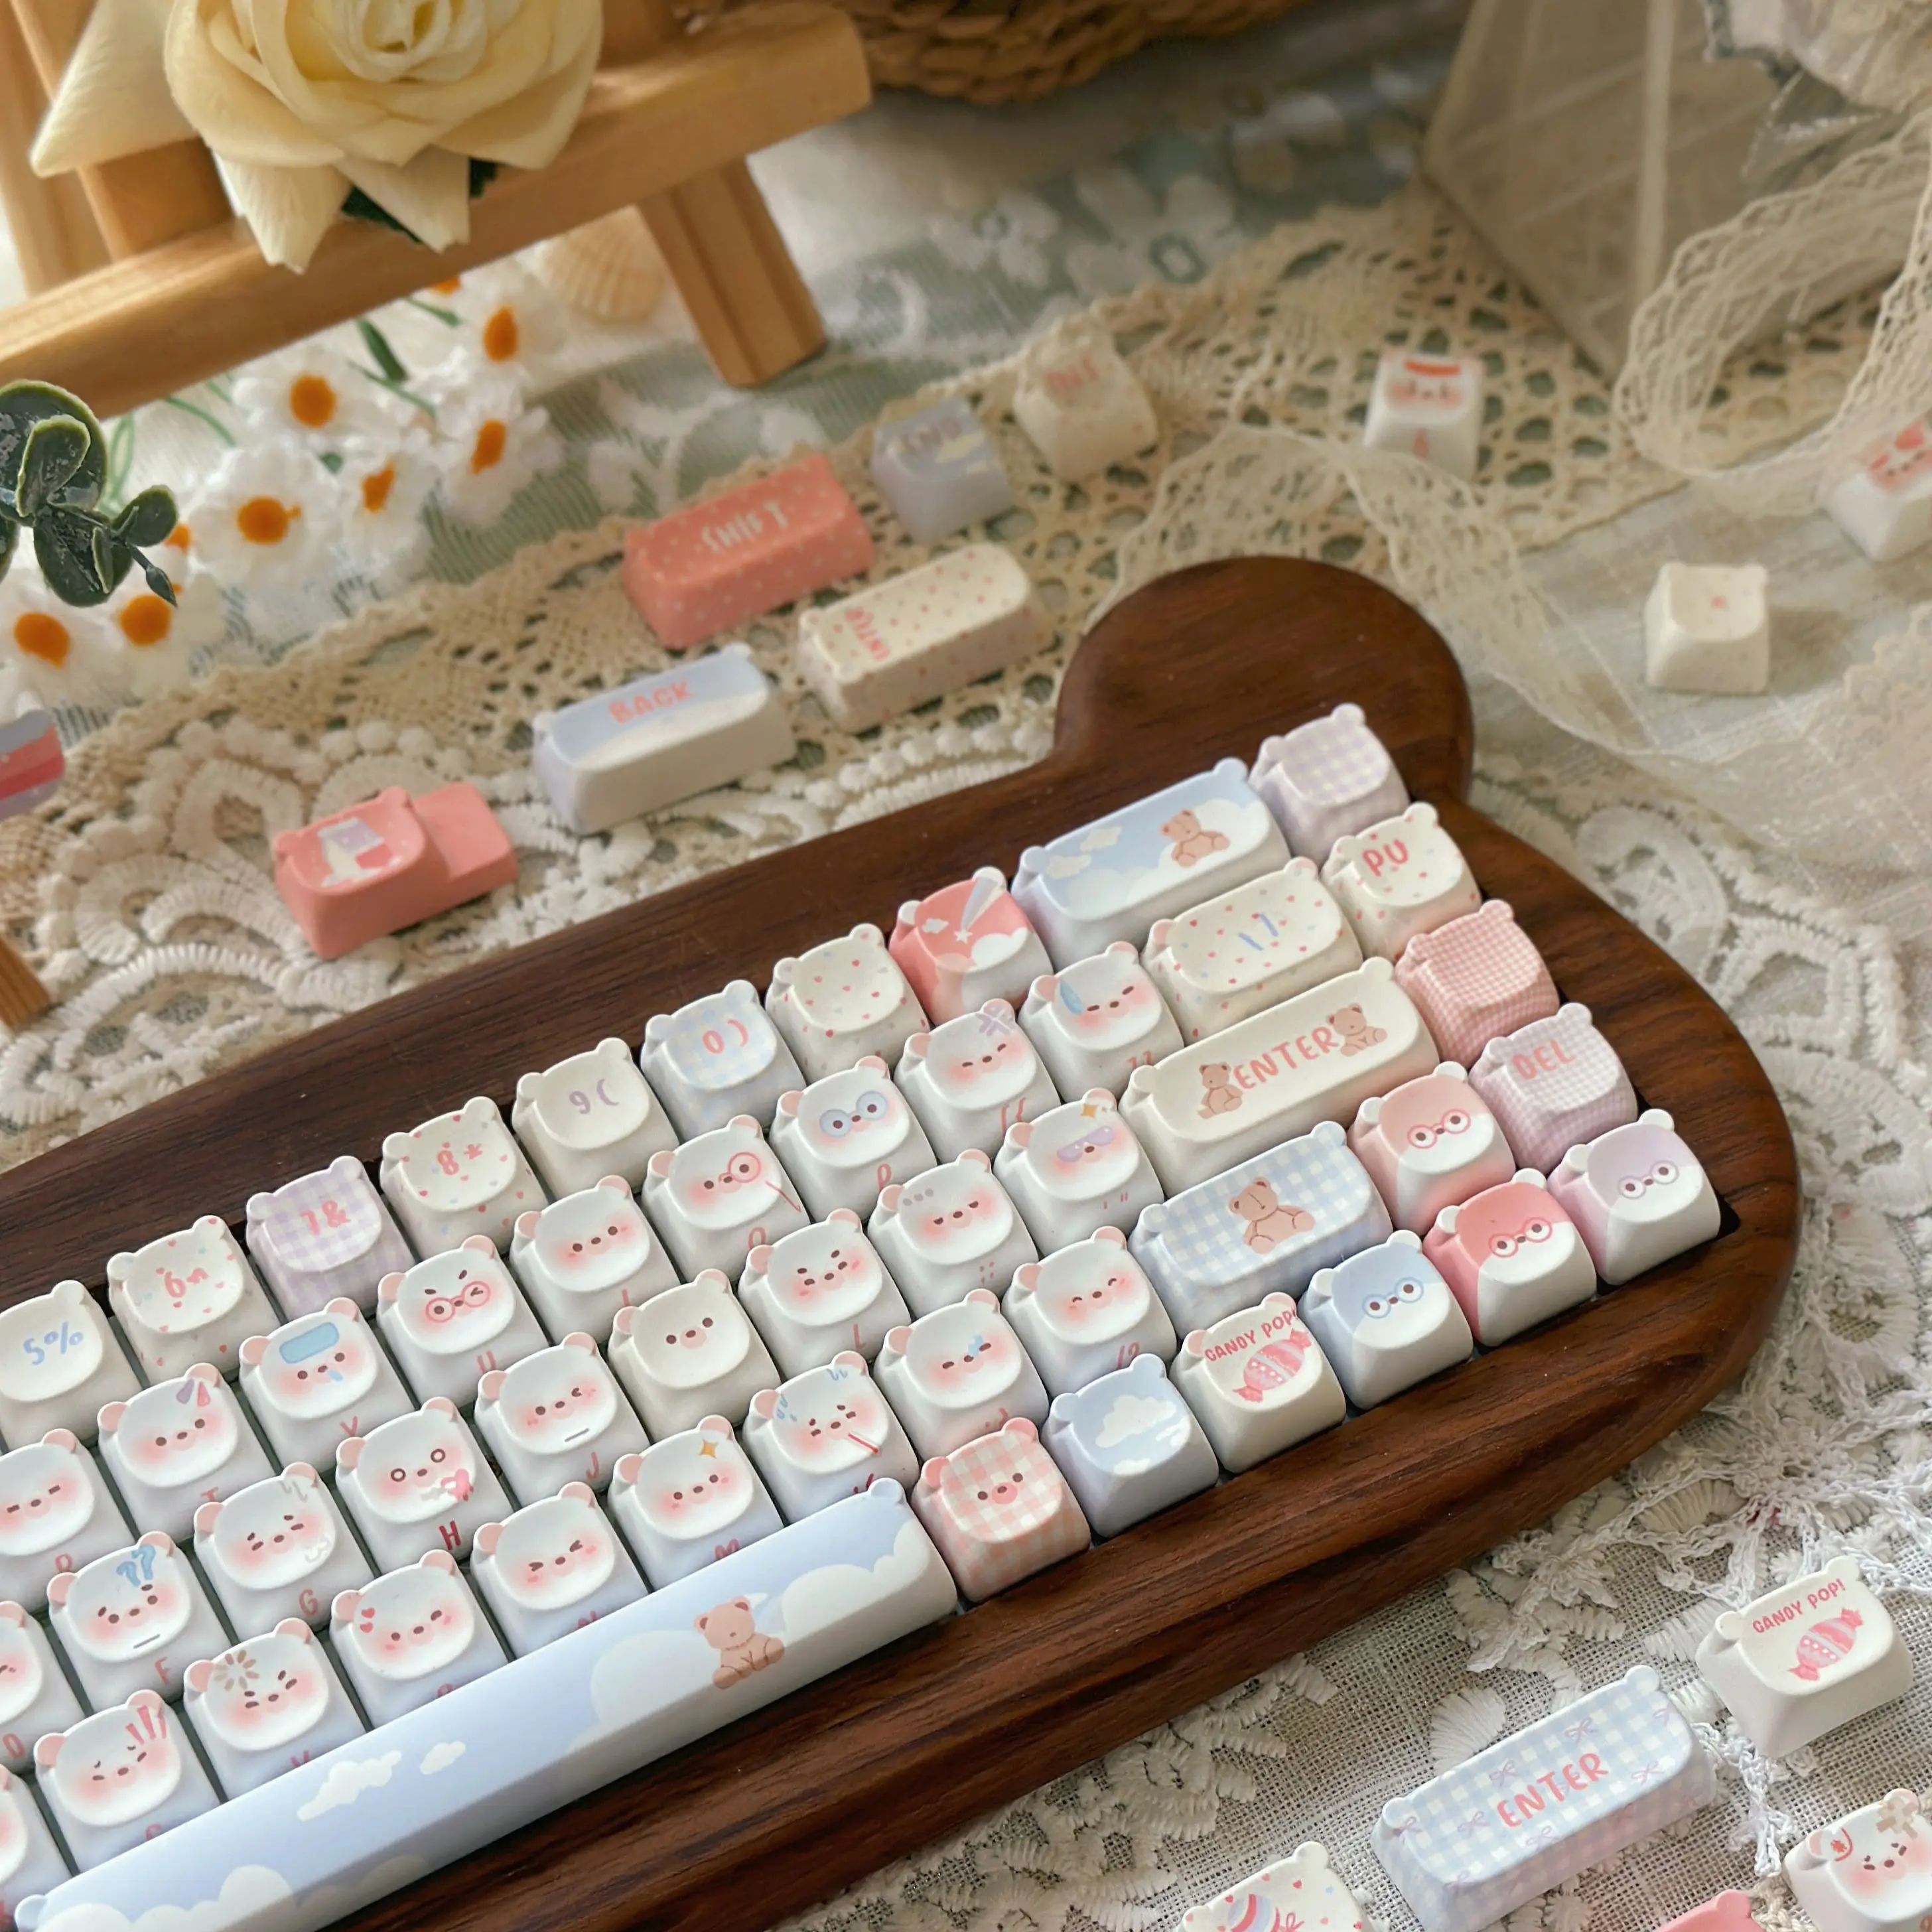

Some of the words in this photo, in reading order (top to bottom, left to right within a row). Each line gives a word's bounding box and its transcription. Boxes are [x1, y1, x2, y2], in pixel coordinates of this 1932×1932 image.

[608, 678, 694, 724] BACK
[1362, 838, 1409, 876] PU
[1233, 1026, 1340, 1089] ENTER
[1511, 1039, 1576, 1080] DEL
[853, 1324, 866, 1349] L
[1204, 1330, 1257, 1361] CANDY
[585, 1452, 599, 1480] J
[439, 1519, 461, 1551] H
[299, 1589, 318, 1617] G
[1752, 1602, 1803, 1634] CANDY
[1808, 1578, 1846, 1608] POP!
[155, 1657, 171, 1686] F
[2, 1732, 25, 1760] D
[1497, 1752, 1609, 1828] ENTER
